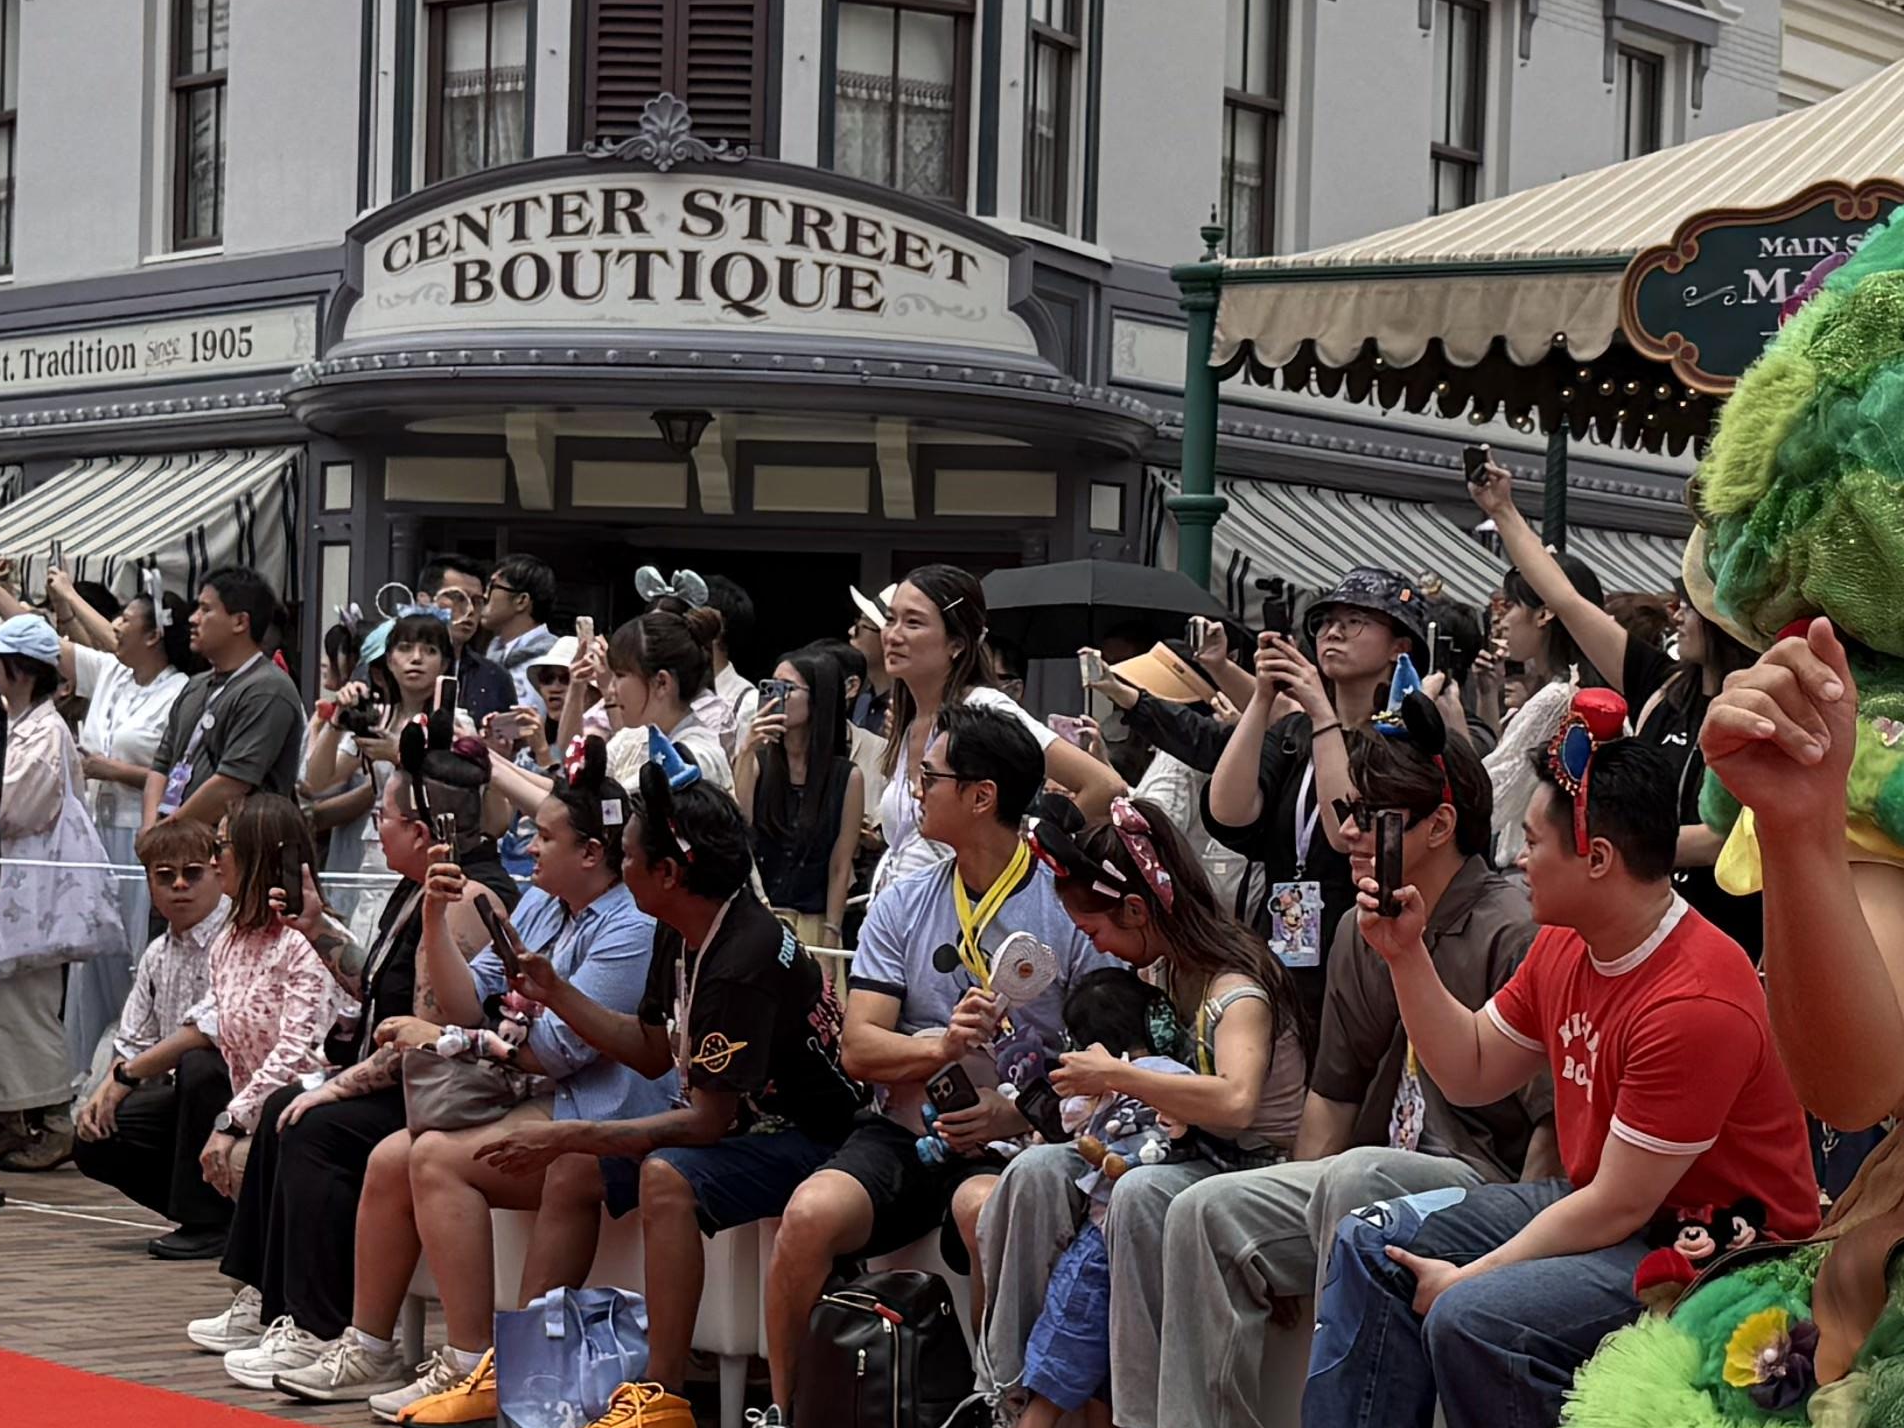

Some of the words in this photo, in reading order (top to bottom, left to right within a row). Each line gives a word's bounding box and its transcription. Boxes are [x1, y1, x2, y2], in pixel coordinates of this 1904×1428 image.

[382, 186, 648, 276] CENTER
[680, 188, 980, 286] STREET
[1758, 236, 1840, 258] MAIN
[451, 249, 887, 320] BOUTIQUE
[20, 337, 137, 380] Tradition
[191, 325, 253, 363] 1905
